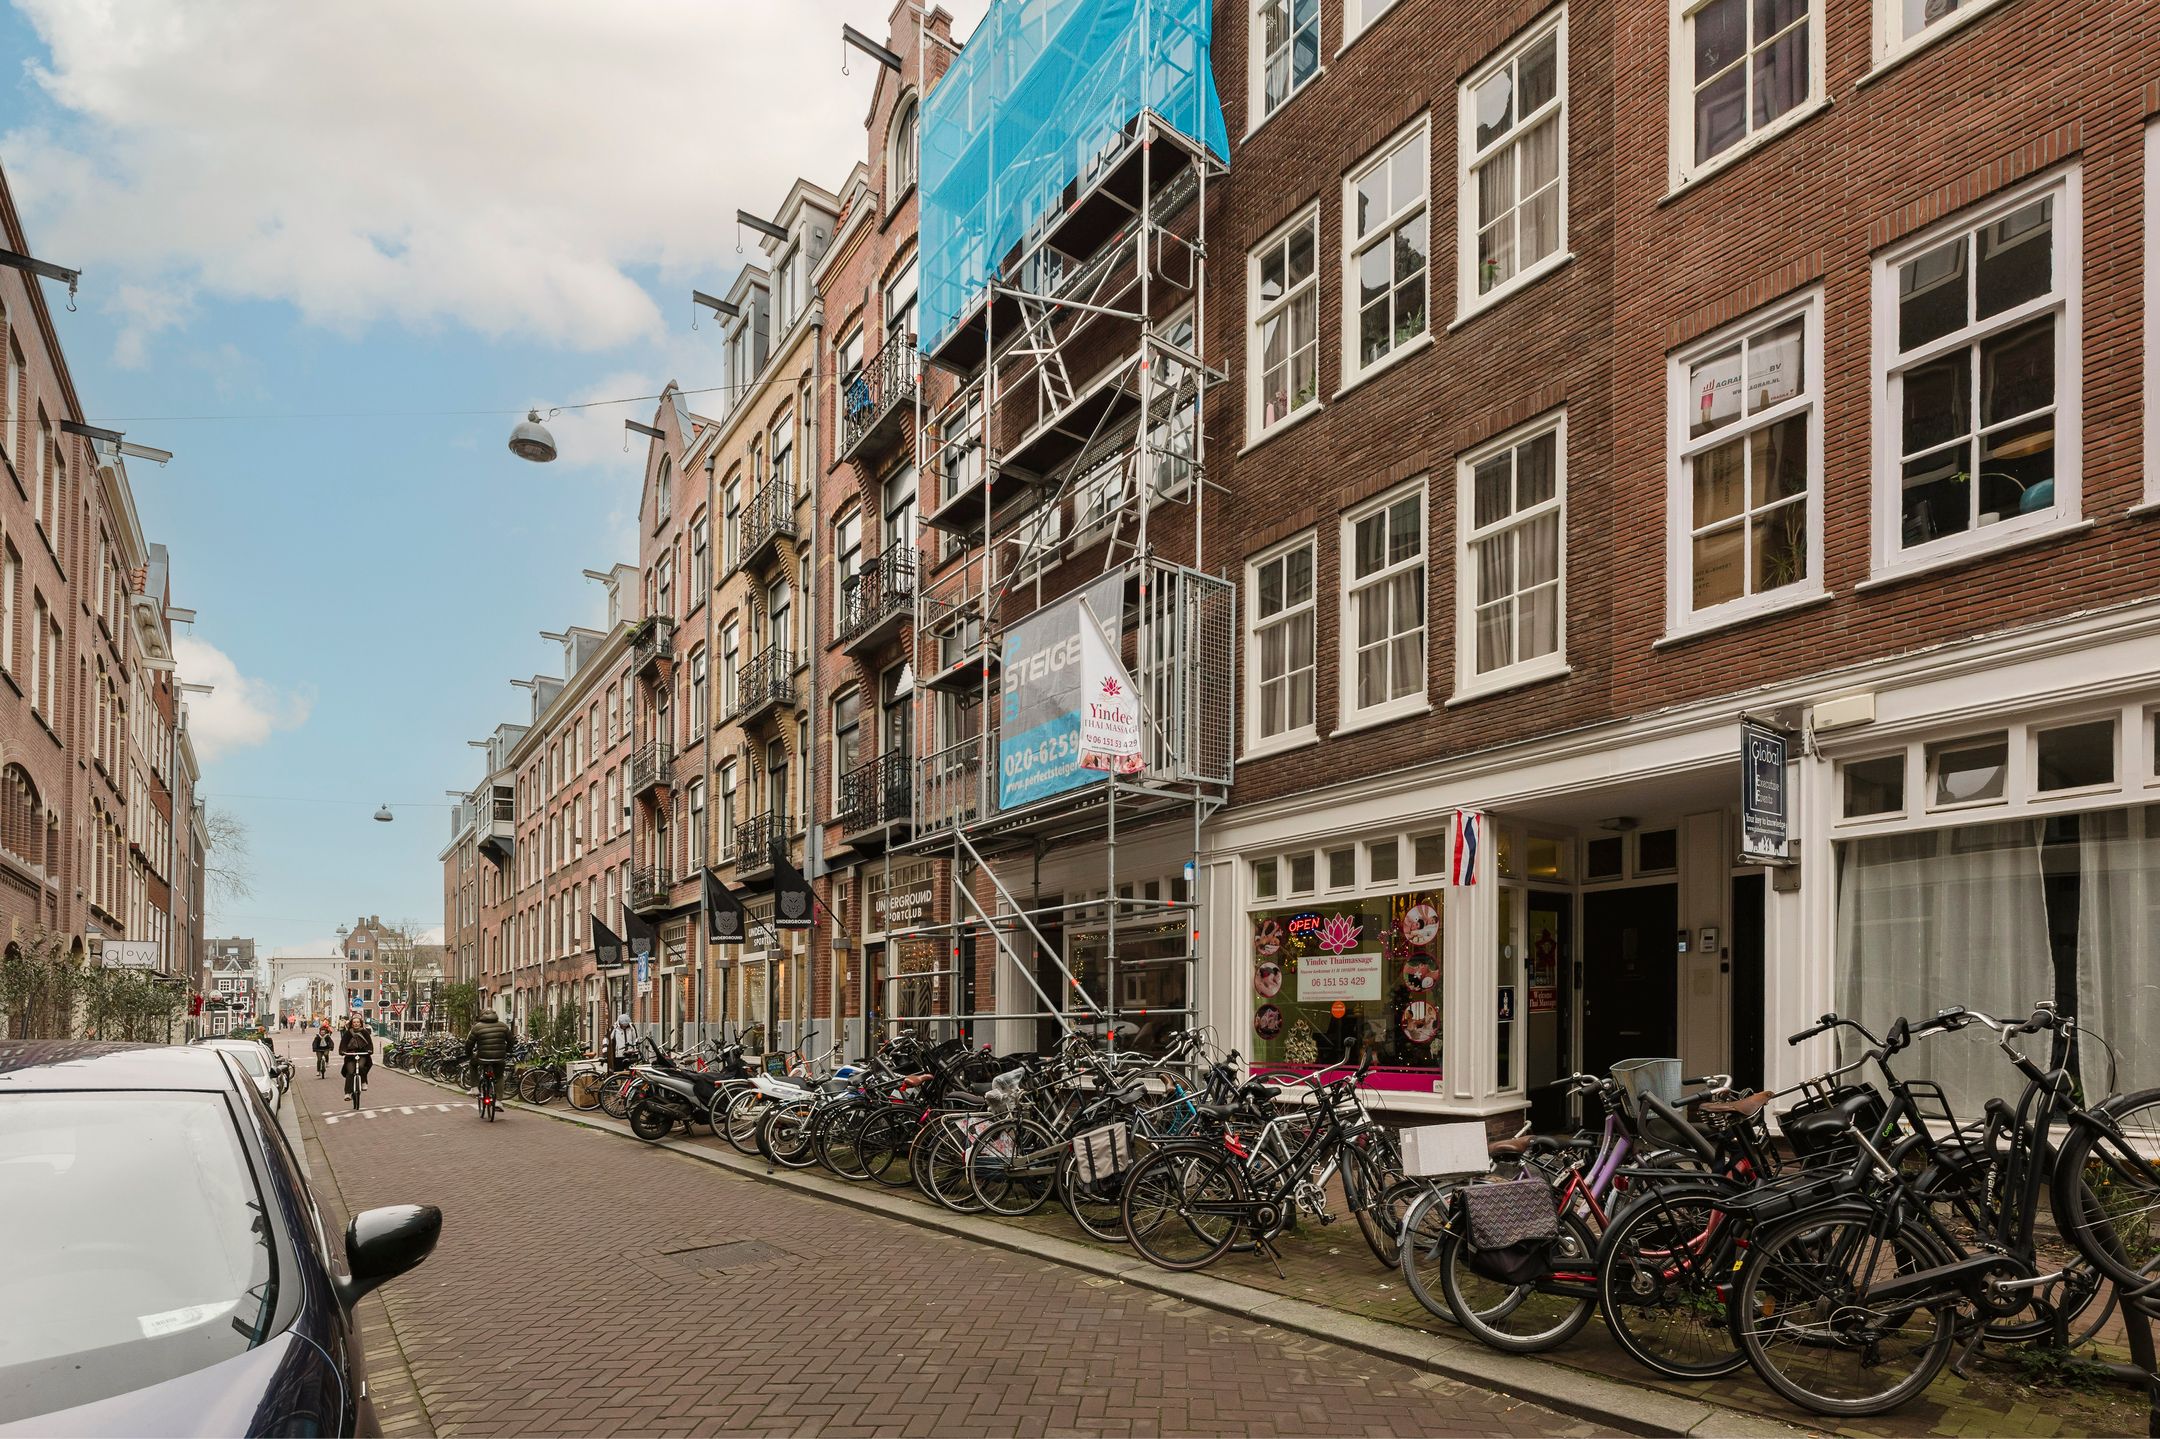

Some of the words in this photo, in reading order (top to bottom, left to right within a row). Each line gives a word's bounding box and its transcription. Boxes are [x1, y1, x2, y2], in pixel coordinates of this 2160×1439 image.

[1769, 363, 1782, 372] BV
[1004, 615, 1117, 694] STEIGES
[1090, 703, 1132, 725] Yindee
[1084, 720, 1104, 734] THAI
[1092, 735, 1101, 744] 06
[1103, 737, 1114, 746] 151
[1115, 739, 1122, 748] 53
[1005, 730, 1079, 777] 020-6259
[1752, 741, 1780, 766] Global
[1006, 760, 1080, 793] www.perfectsteiger
[1755, 774, 1780, 791] Executive
[1755, 789, 1773, 804] Events
[1745, 812, 1755, 823] Your
[1762, 816, 1767, 826] to
[1766, 816, 1785, 830] knowledge
[875, 889, 932, 912] UNERGROUND
[1289, 917, 1320, 931] OPEN
[105, 943, 155, 967] glow
[1306, 958, 1328, 966] Yindee
[1329, 956, 1374, 965] Thaimassage
[1312, 978, 1321, 987] 06
[1323, 978, 1336, 987] 151
[1339, 977, 1348, 986] 53
[1350, 976, 1366, 986] 429
